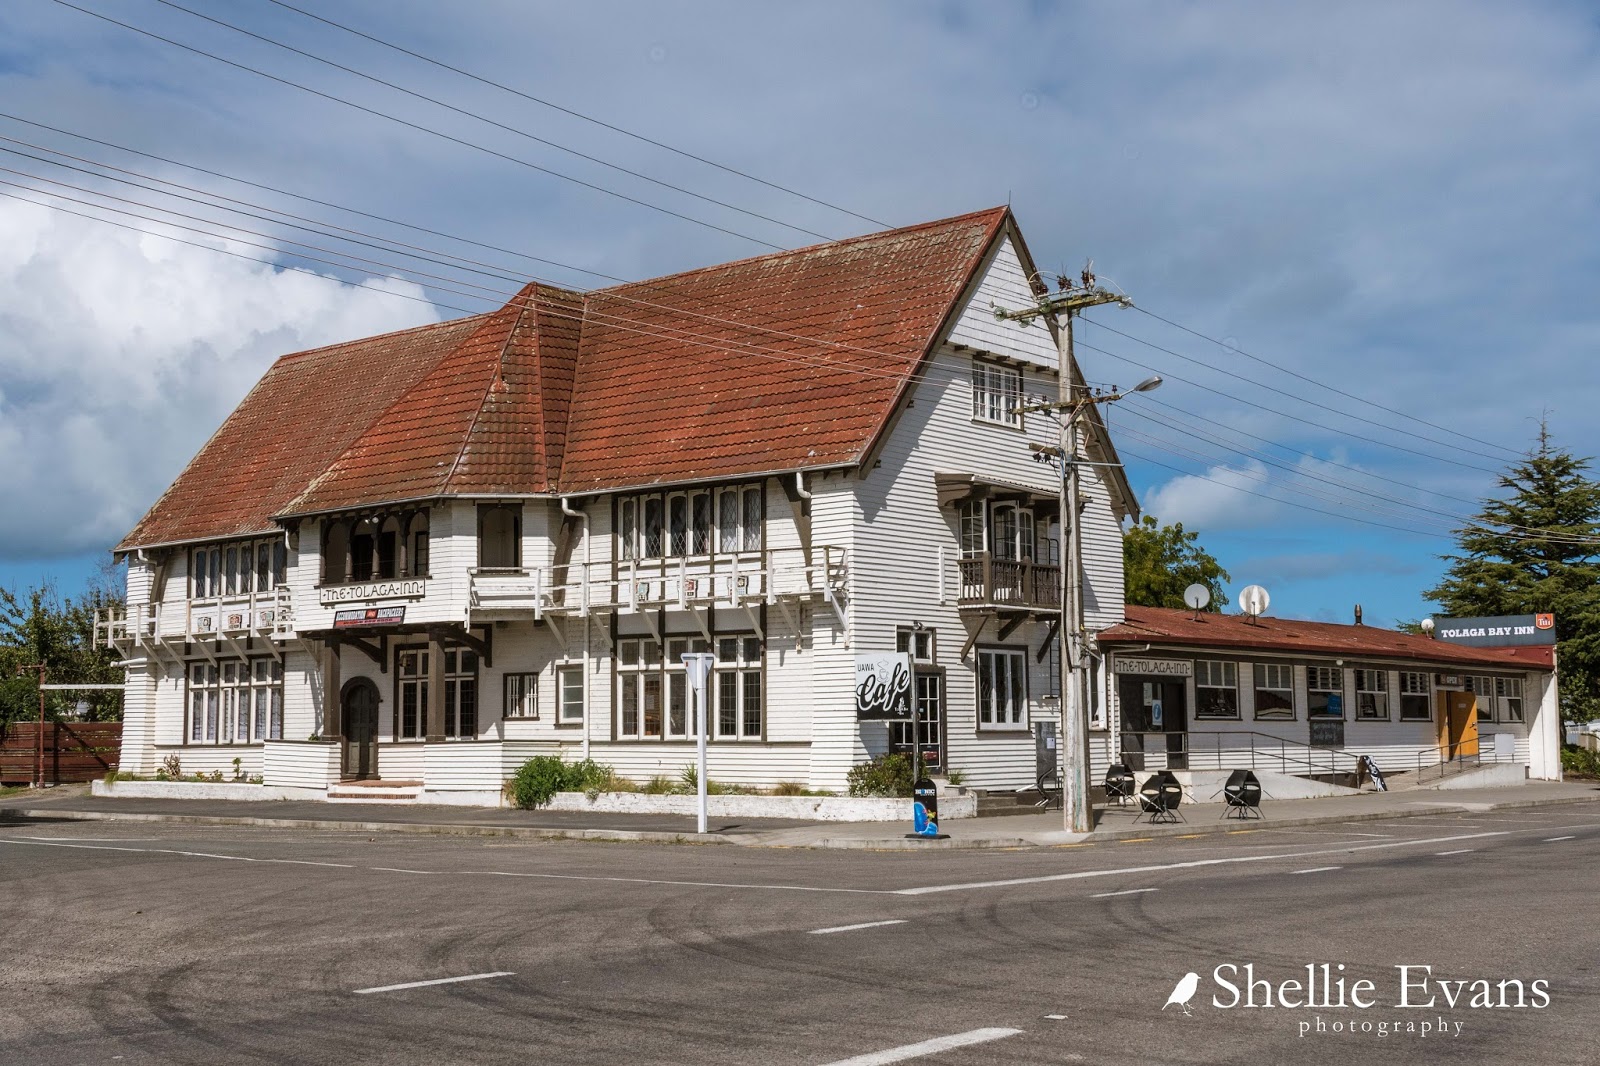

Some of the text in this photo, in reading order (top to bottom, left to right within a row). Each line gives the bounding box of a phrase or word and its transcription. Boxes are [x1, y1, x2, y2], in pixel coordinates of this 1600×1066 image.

[349, 583, 398, 599] TOLAGA
[377, 607, 404, 618] BACKPACKERS
[1537, 618, 1551, 626] Tui
[1441, 626, 1535, 638] TOLAGA BAY INN
[857, 663, 875, 672] UAWA
[1136, 661, 1173, 674] TOLAGA
